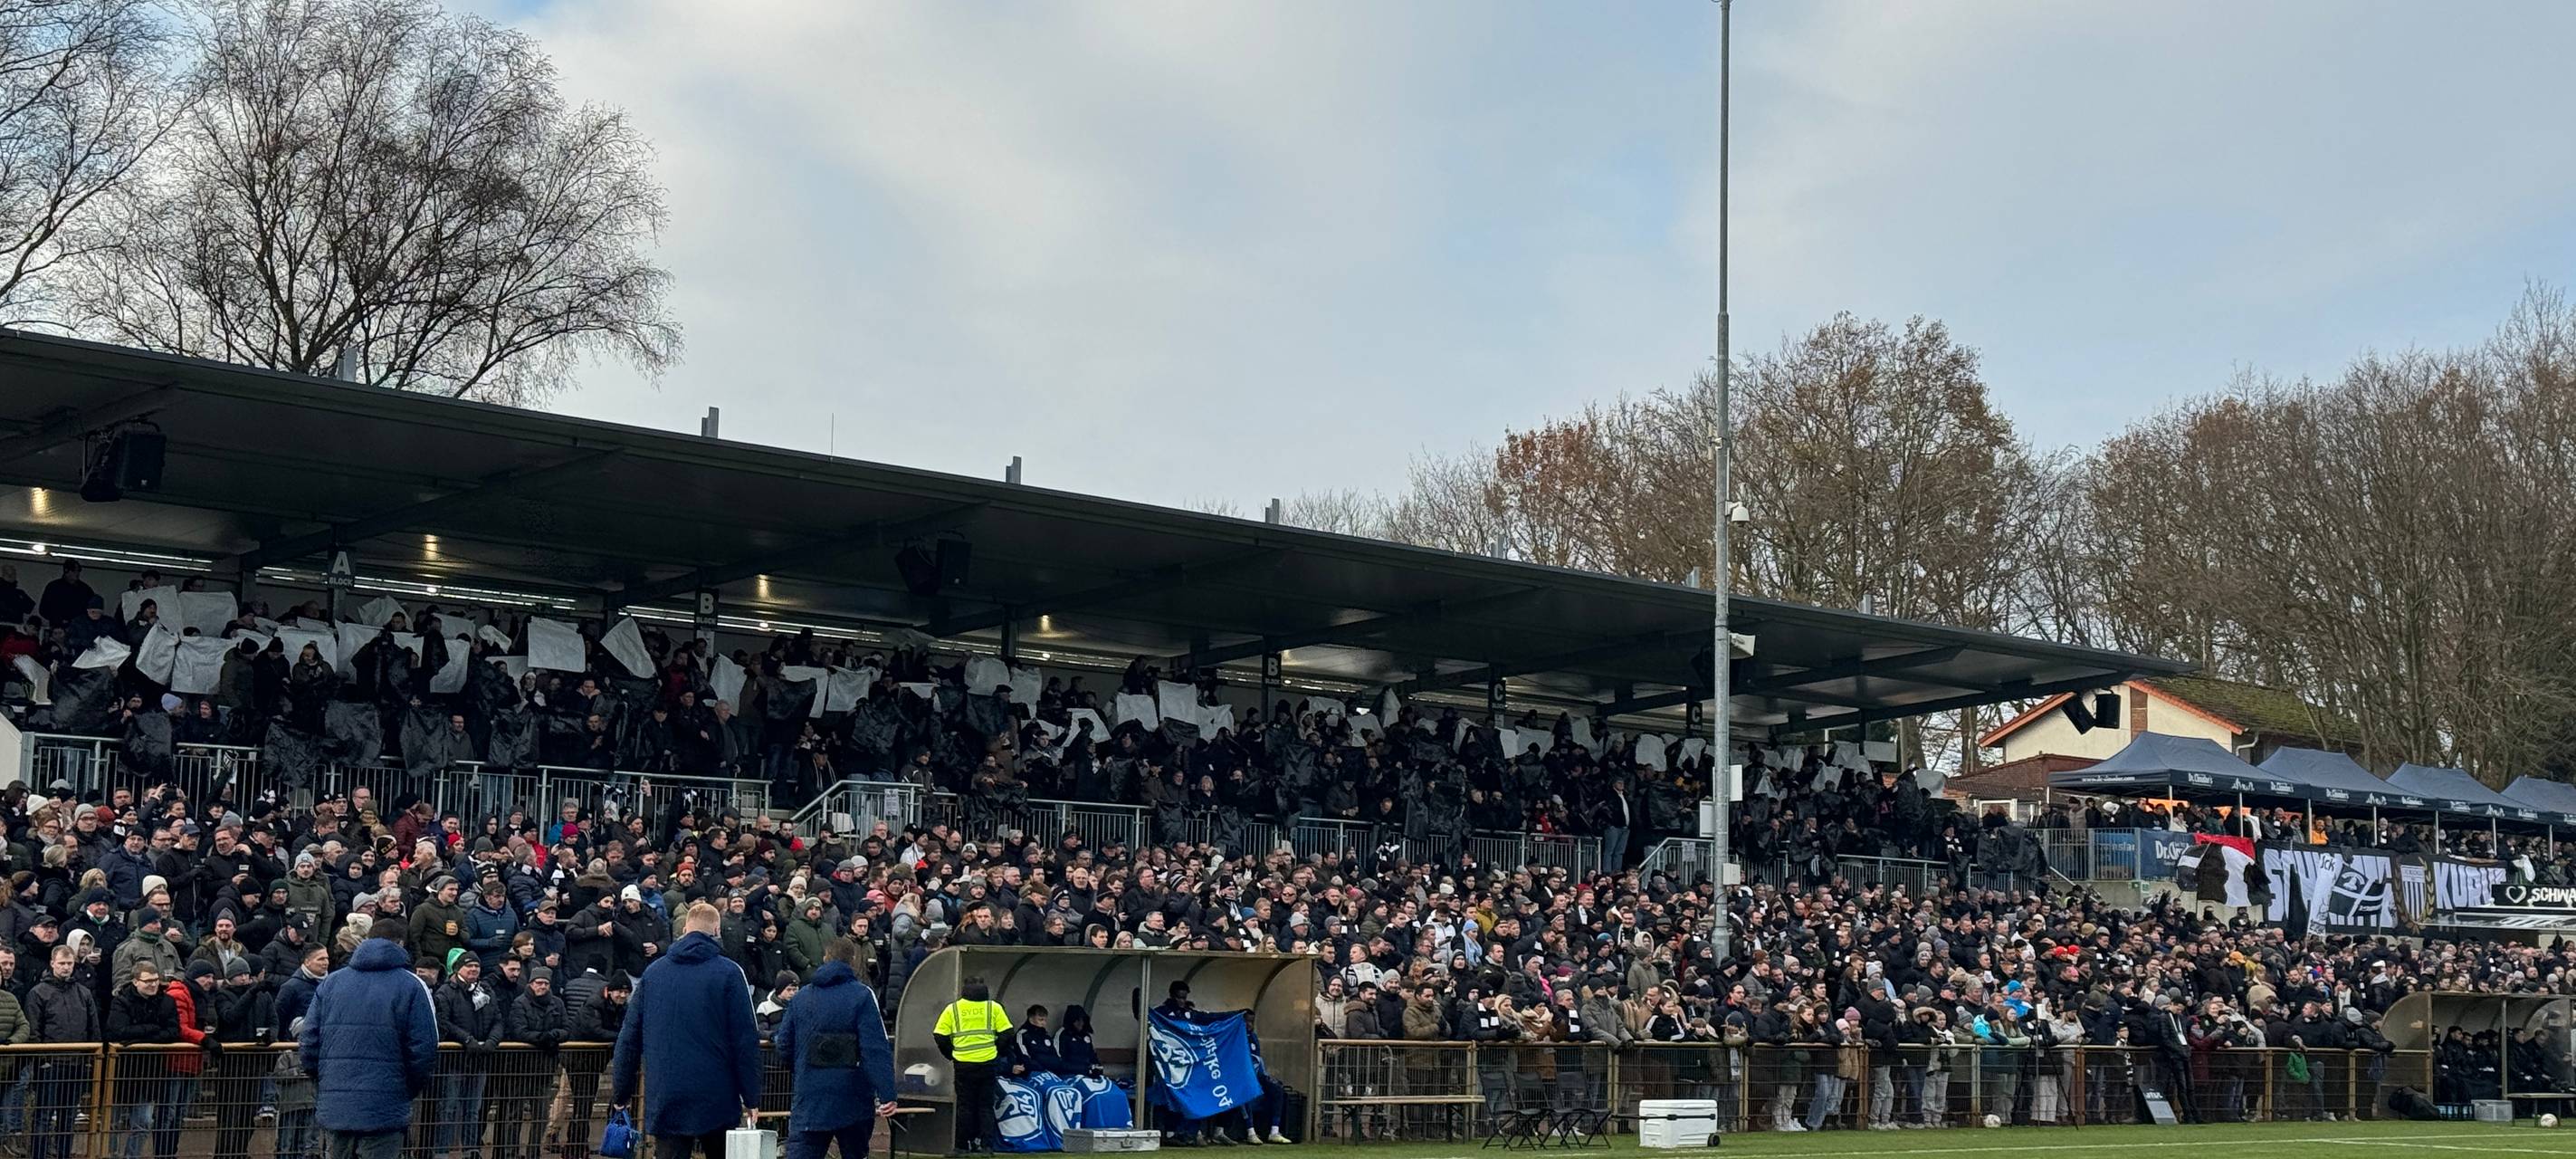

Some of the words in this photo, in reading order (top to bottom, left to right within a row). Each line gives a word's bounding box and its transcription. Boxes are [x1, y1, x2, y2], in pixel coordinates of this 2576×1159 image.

[332, 551, 351, 575] A
[329, 577, 353, 587] BLOCK
[700, 593, 713, 614] B
[1268, 657, 1277, 675] B
[1494, 684, 1503, 701] C
[1692, 706, 1701, 723] C
